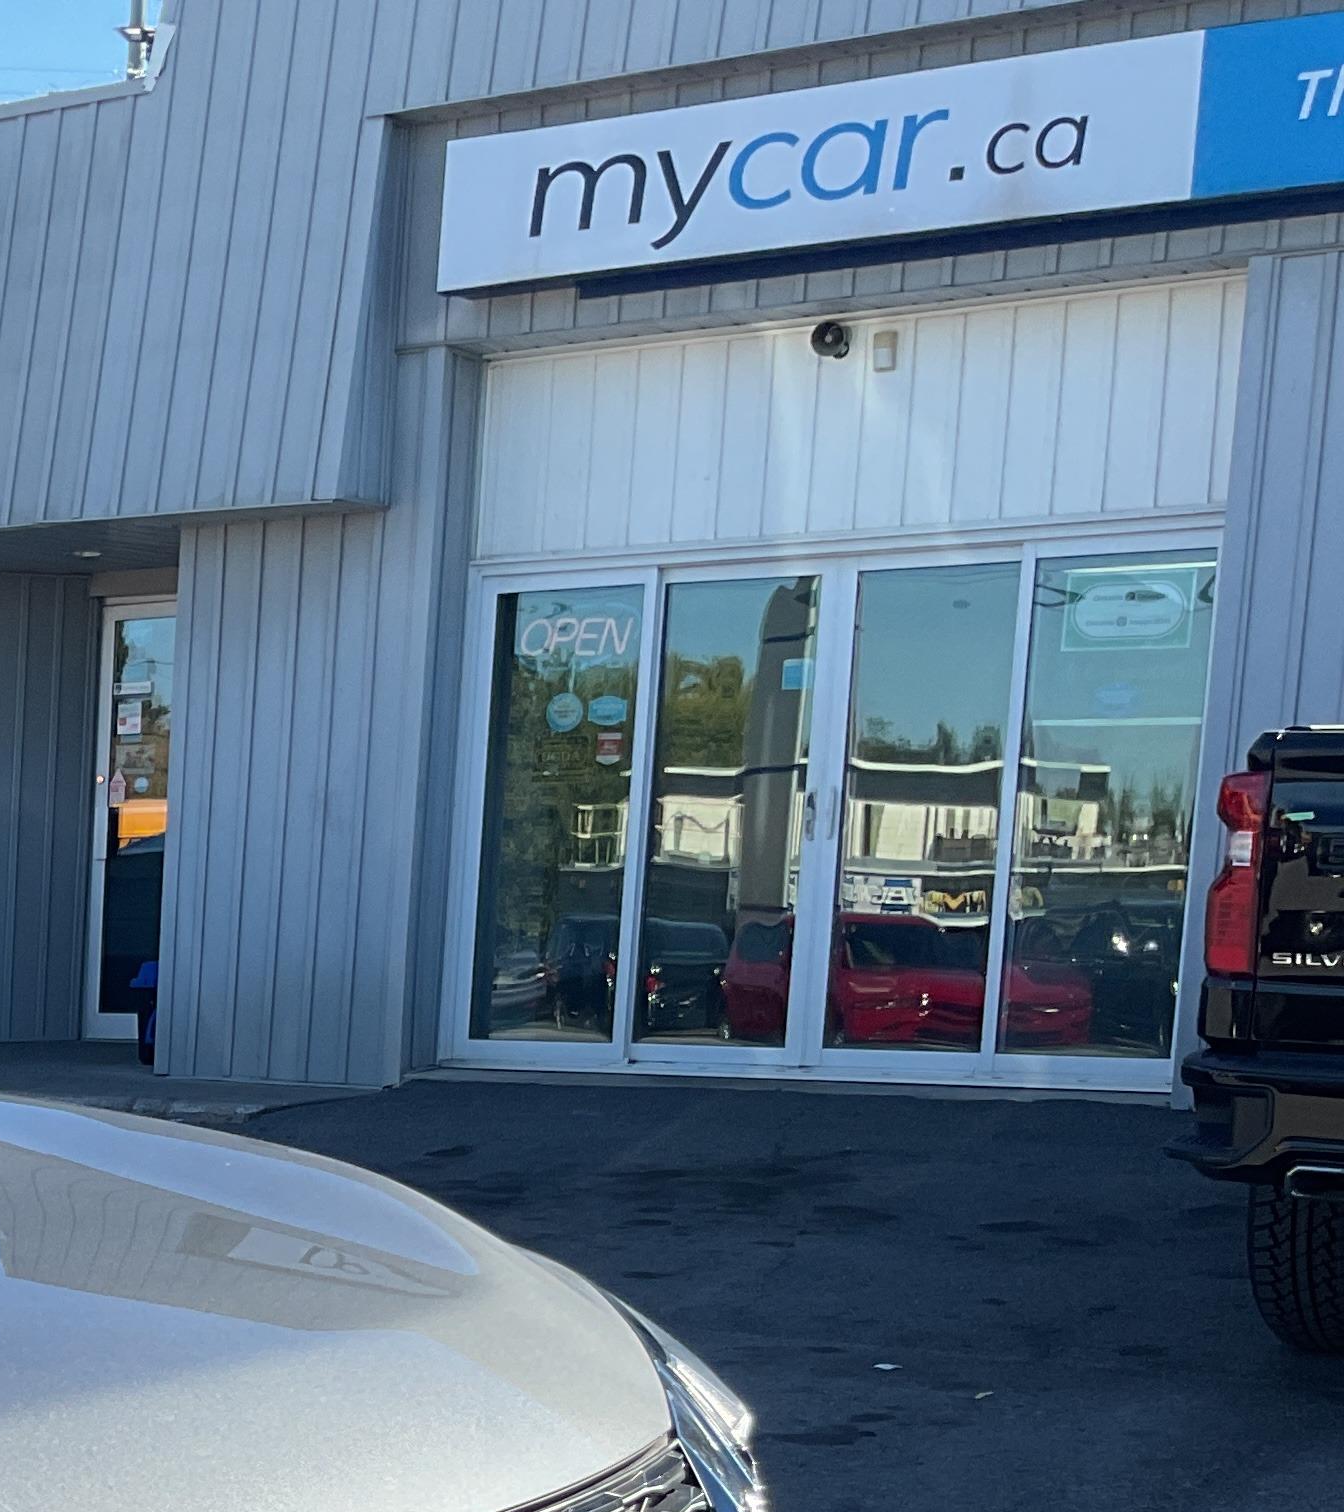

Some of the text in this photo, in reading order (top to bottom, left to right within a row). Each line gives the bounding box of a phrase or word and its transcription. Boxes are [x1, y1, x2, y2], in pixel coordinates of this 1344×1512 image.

[528, 107, 1089, 251] mycar.ca
[520, 617, 634, 657] OPEN
[1272, 952, 1344, 967] SILV
